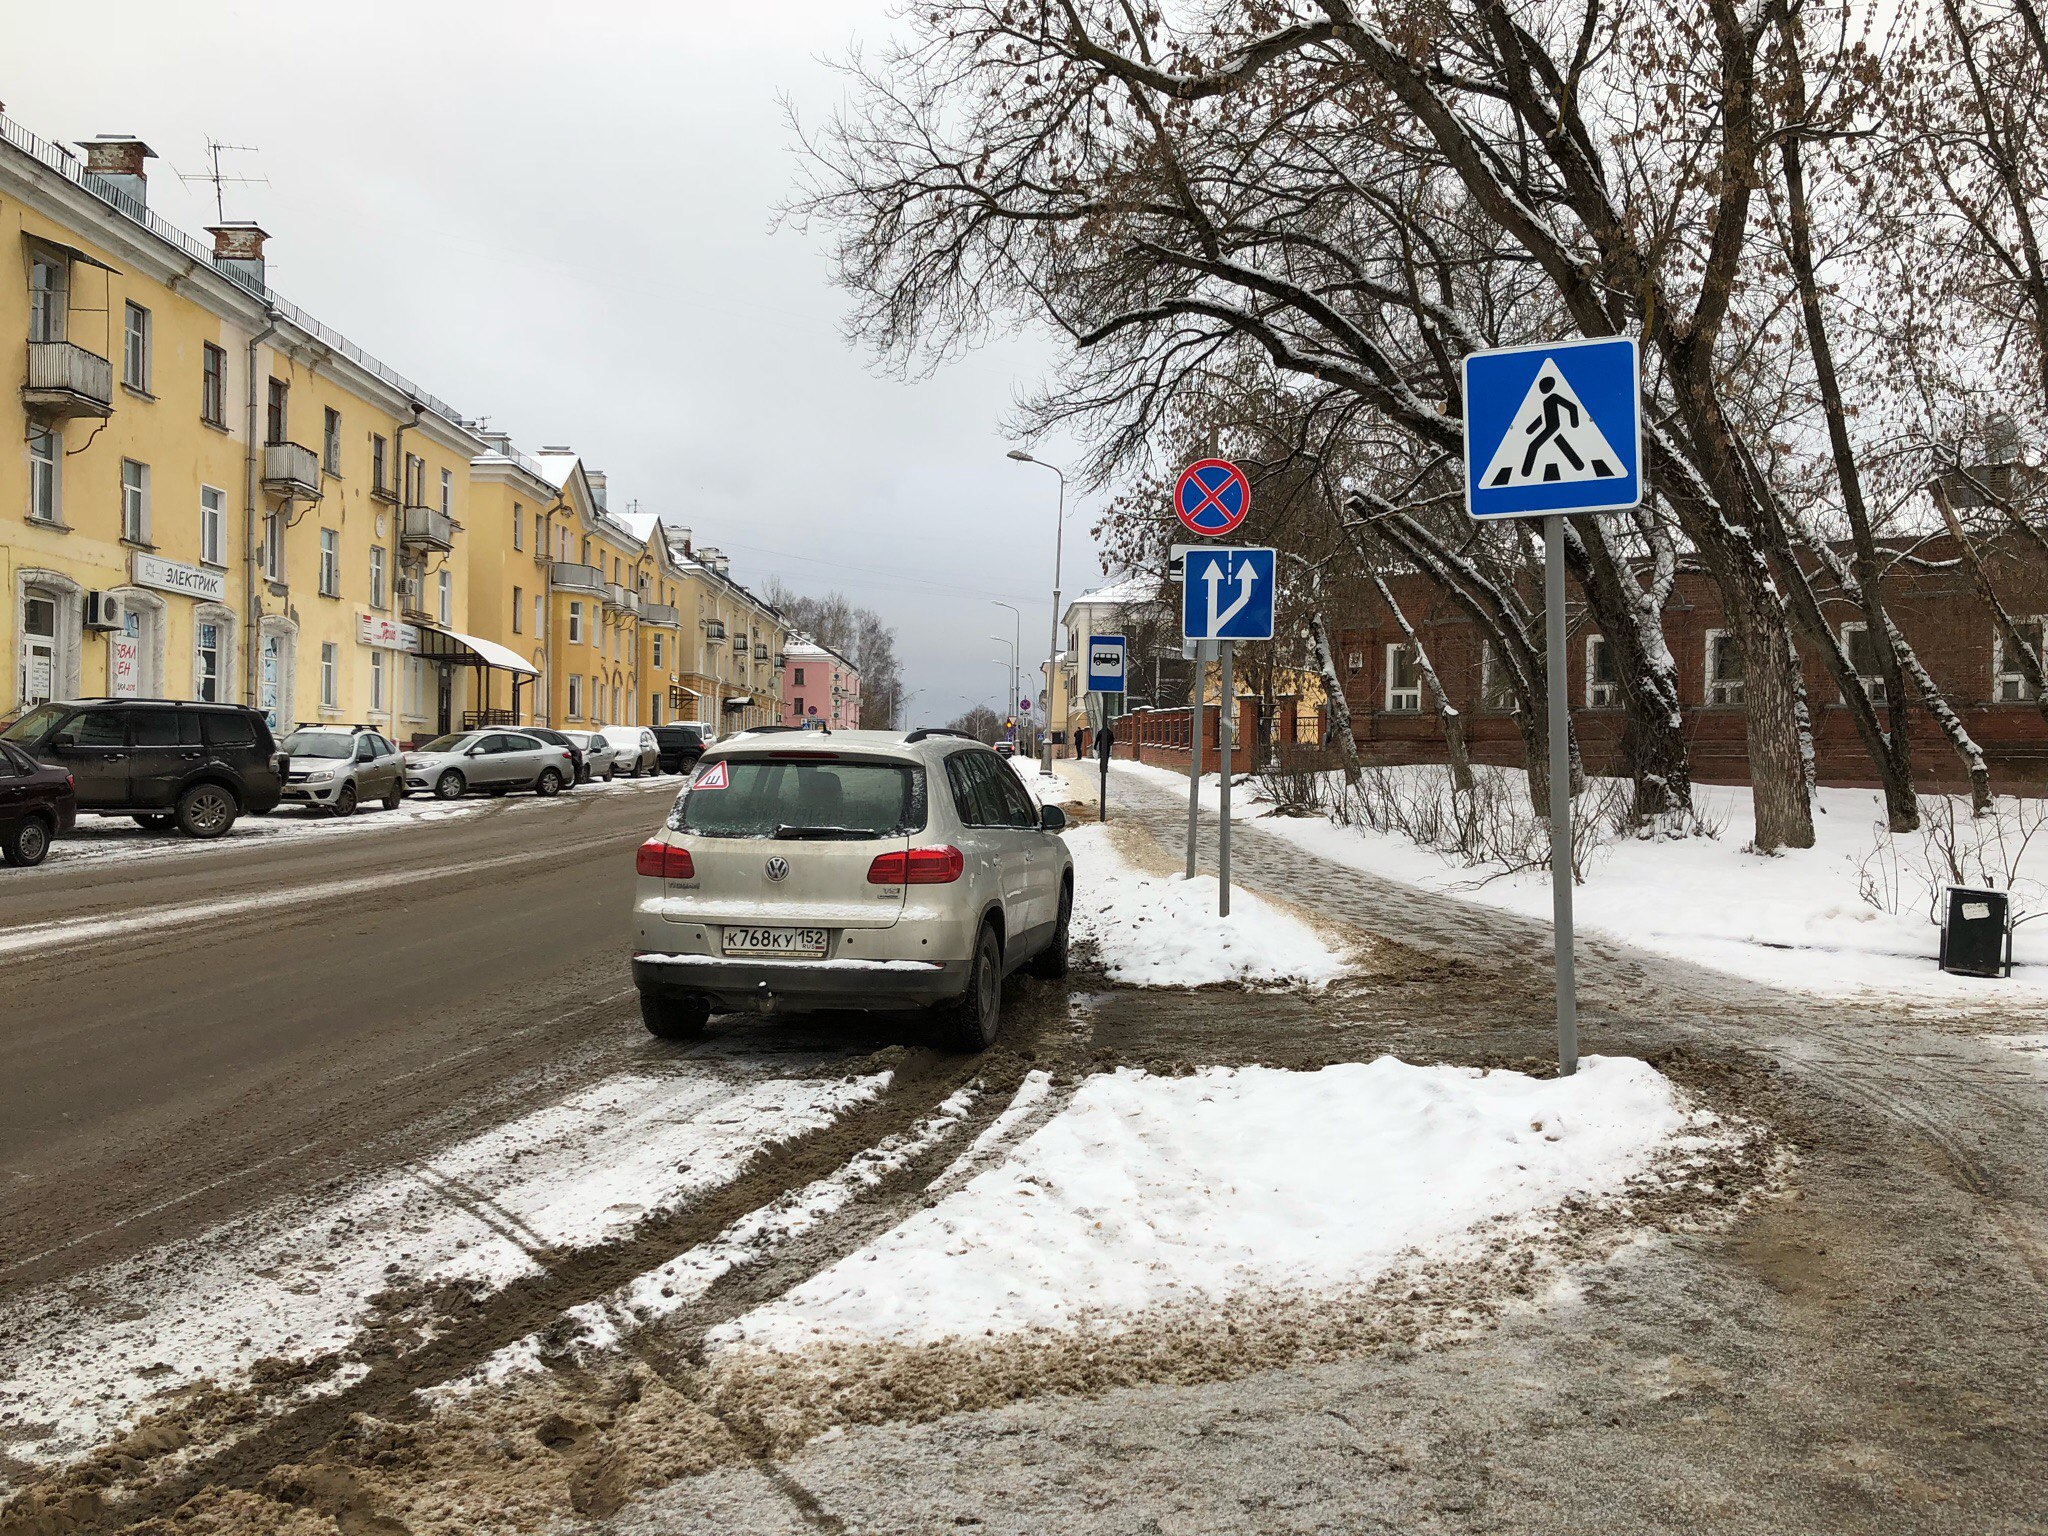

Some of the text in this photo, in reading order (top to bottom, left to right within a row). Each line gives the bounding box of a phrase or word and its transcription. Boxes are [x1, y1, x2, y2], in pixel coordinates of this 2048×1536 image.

[166, 567, 218, 593] ЭЛЕКТРИК
[705, 775, 721, 785] Ш
[797, 930, 824, 945] 152
